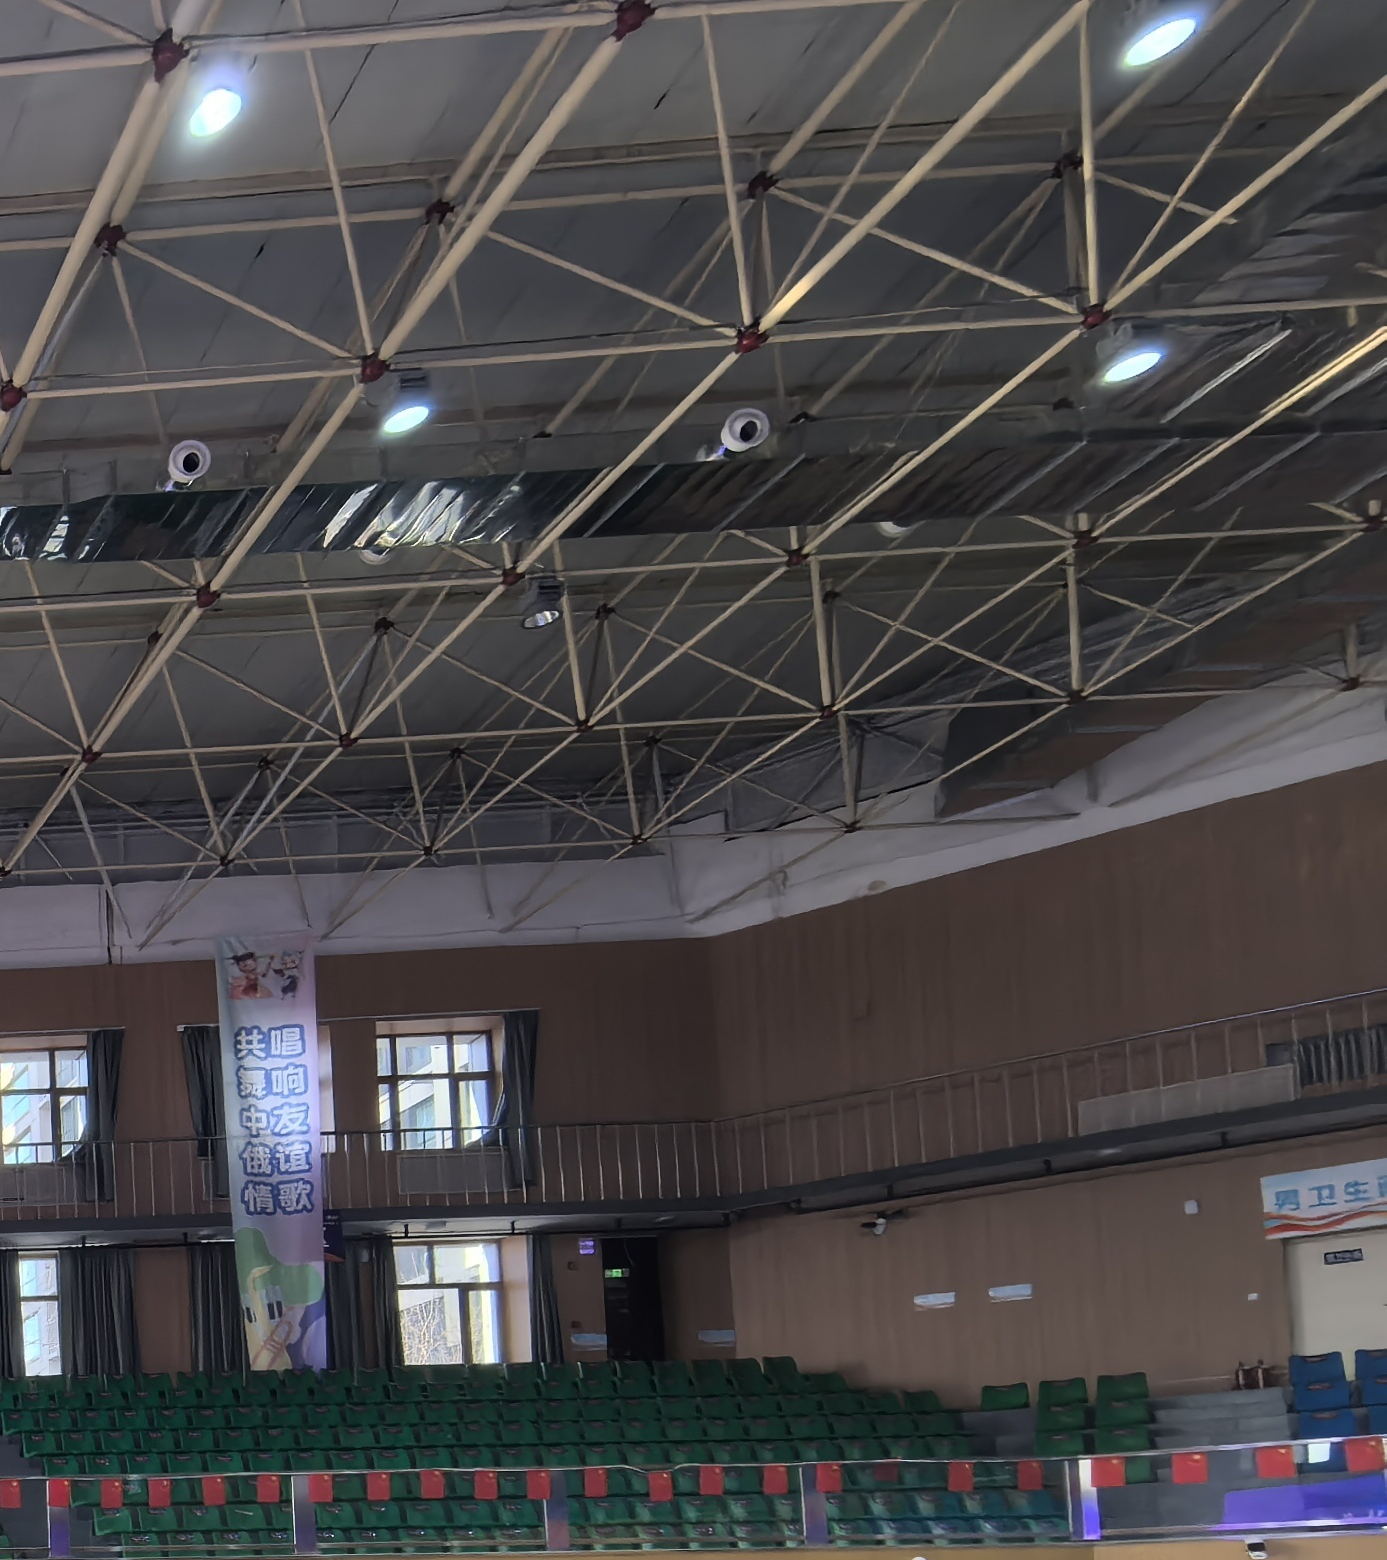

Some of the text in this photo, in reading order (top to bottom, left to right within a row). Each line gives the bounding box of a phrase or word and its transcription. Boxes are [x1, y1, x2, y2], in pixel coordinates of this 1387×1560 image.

[268, 1025, 314, 1215] 唱响友谊歌
